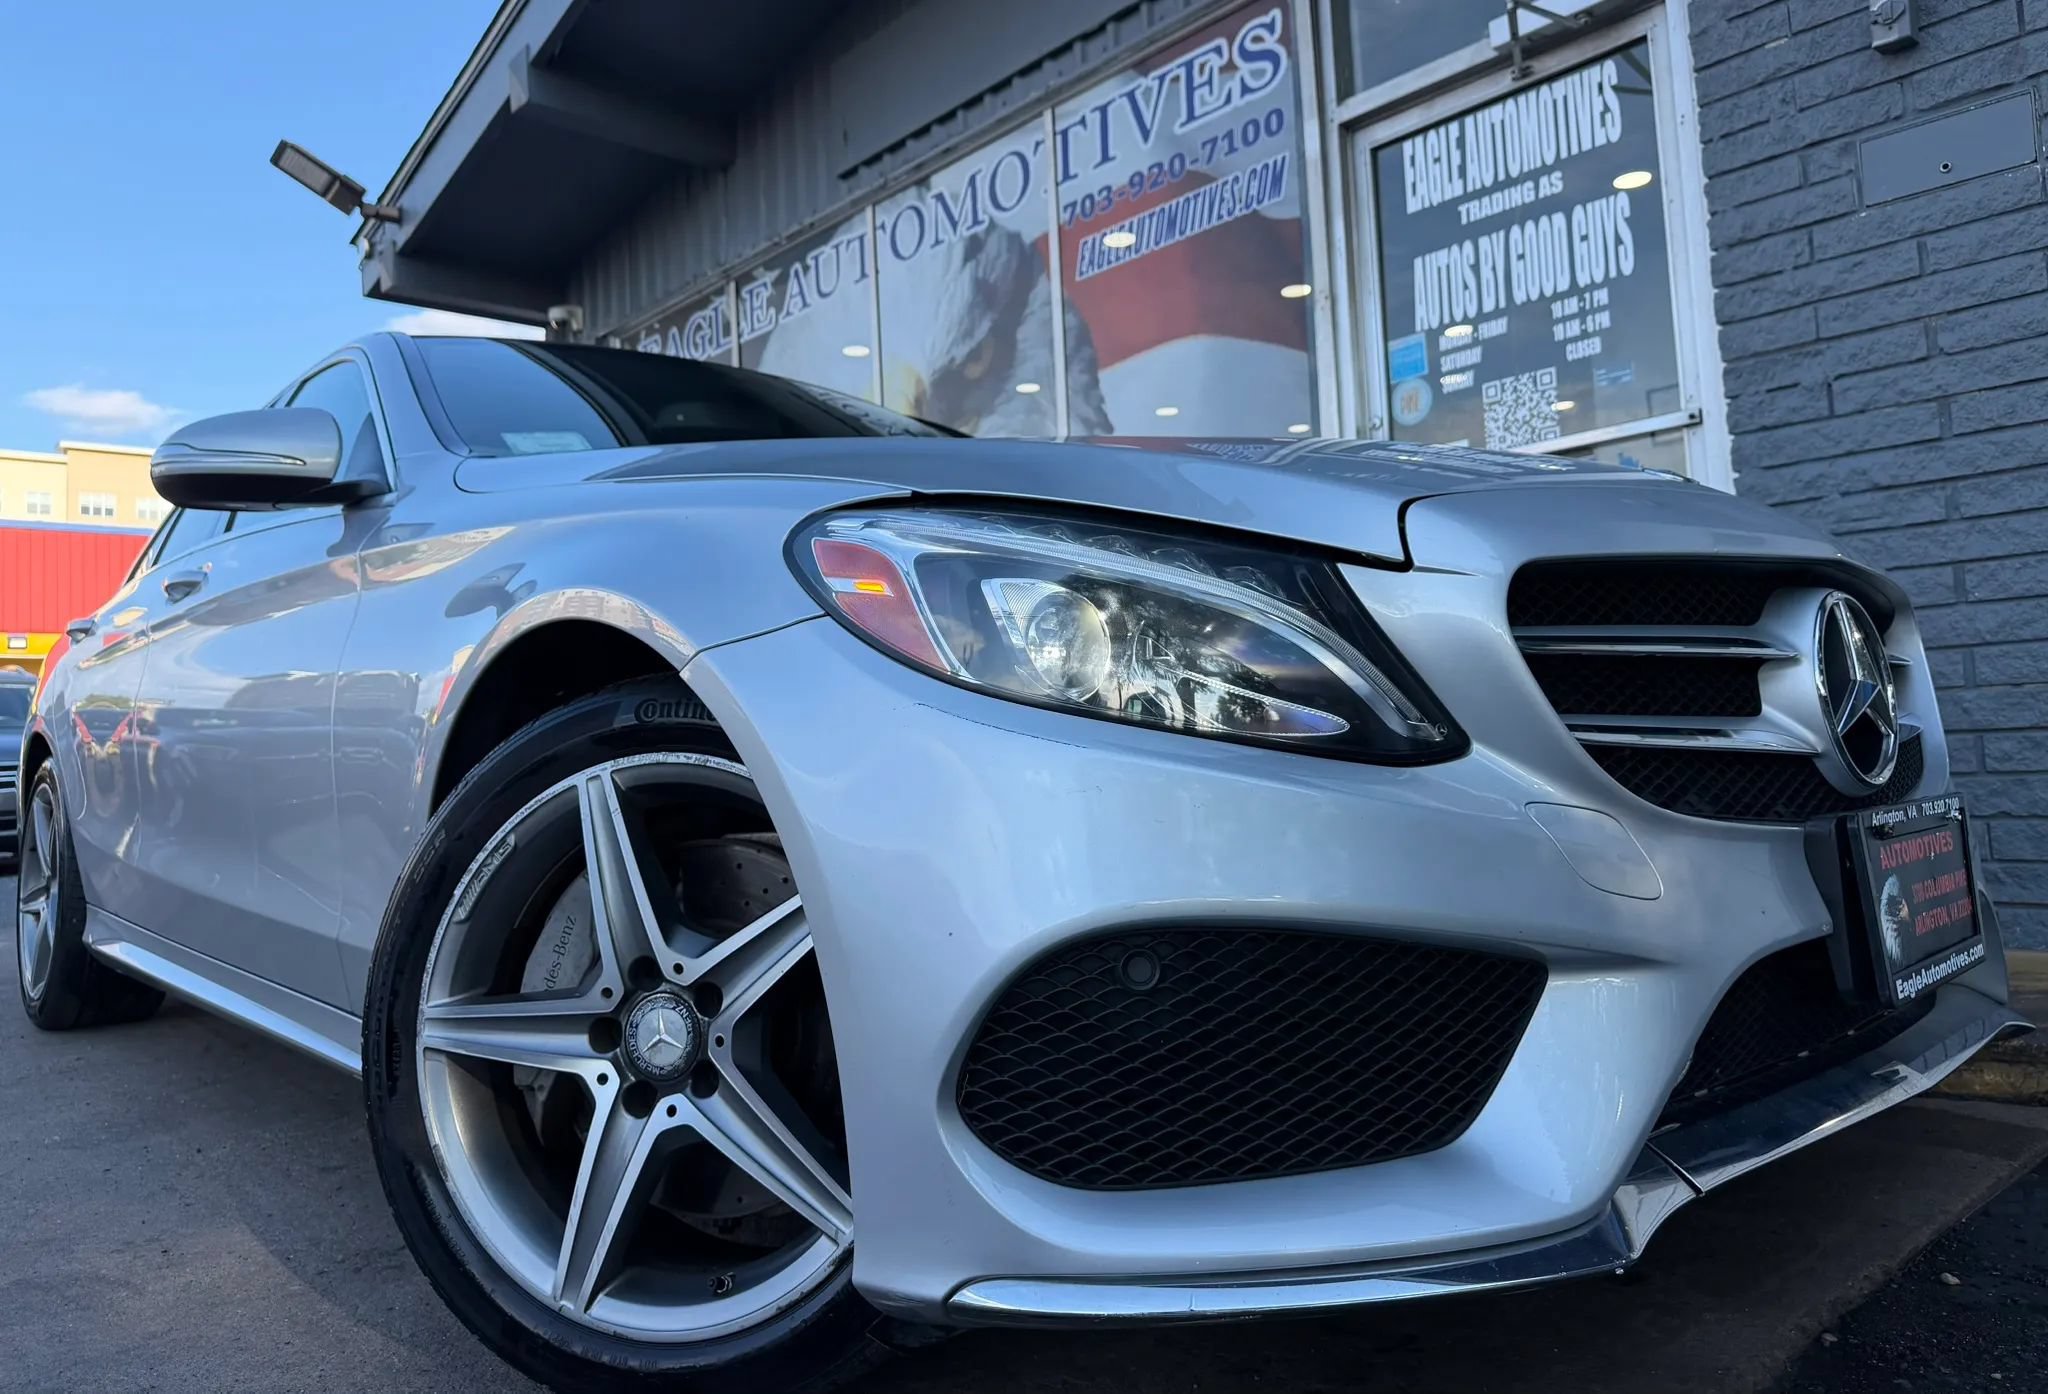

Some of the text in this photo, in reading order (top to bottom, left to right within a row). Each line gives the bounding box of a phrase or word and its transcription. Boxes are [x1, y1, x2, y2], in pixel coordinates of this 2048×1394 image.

[779, 8, 1287, 321] AUTOMOTIVES
[1402, 60, 1622, 215] EAGLE AUTOMOTIVES
[1063, 108, 1285, 228] 703-920-7100
[1076, 153, 1289, 281] EAGLEAUTOMOTIVES.COM
[1458, 171, 1564, 225] TRADING AS
[1413, 191, 1635, 332] AUTOS BY GOOD GUYS
[1592, 286, 1609, 309] PM
[1594, 309, 1611, 331] PM
[1566, 336, 1602, 362] CLOSED
[1872, 796, 1960, 828] Arlington, VA 703.920.7100
[1879, 831, 1954, 870] AUTOMOTIVES
[543, 915, 577, 992] des-Benz
[1895, 943, 1985, 1000] EagleAutomotives.com
